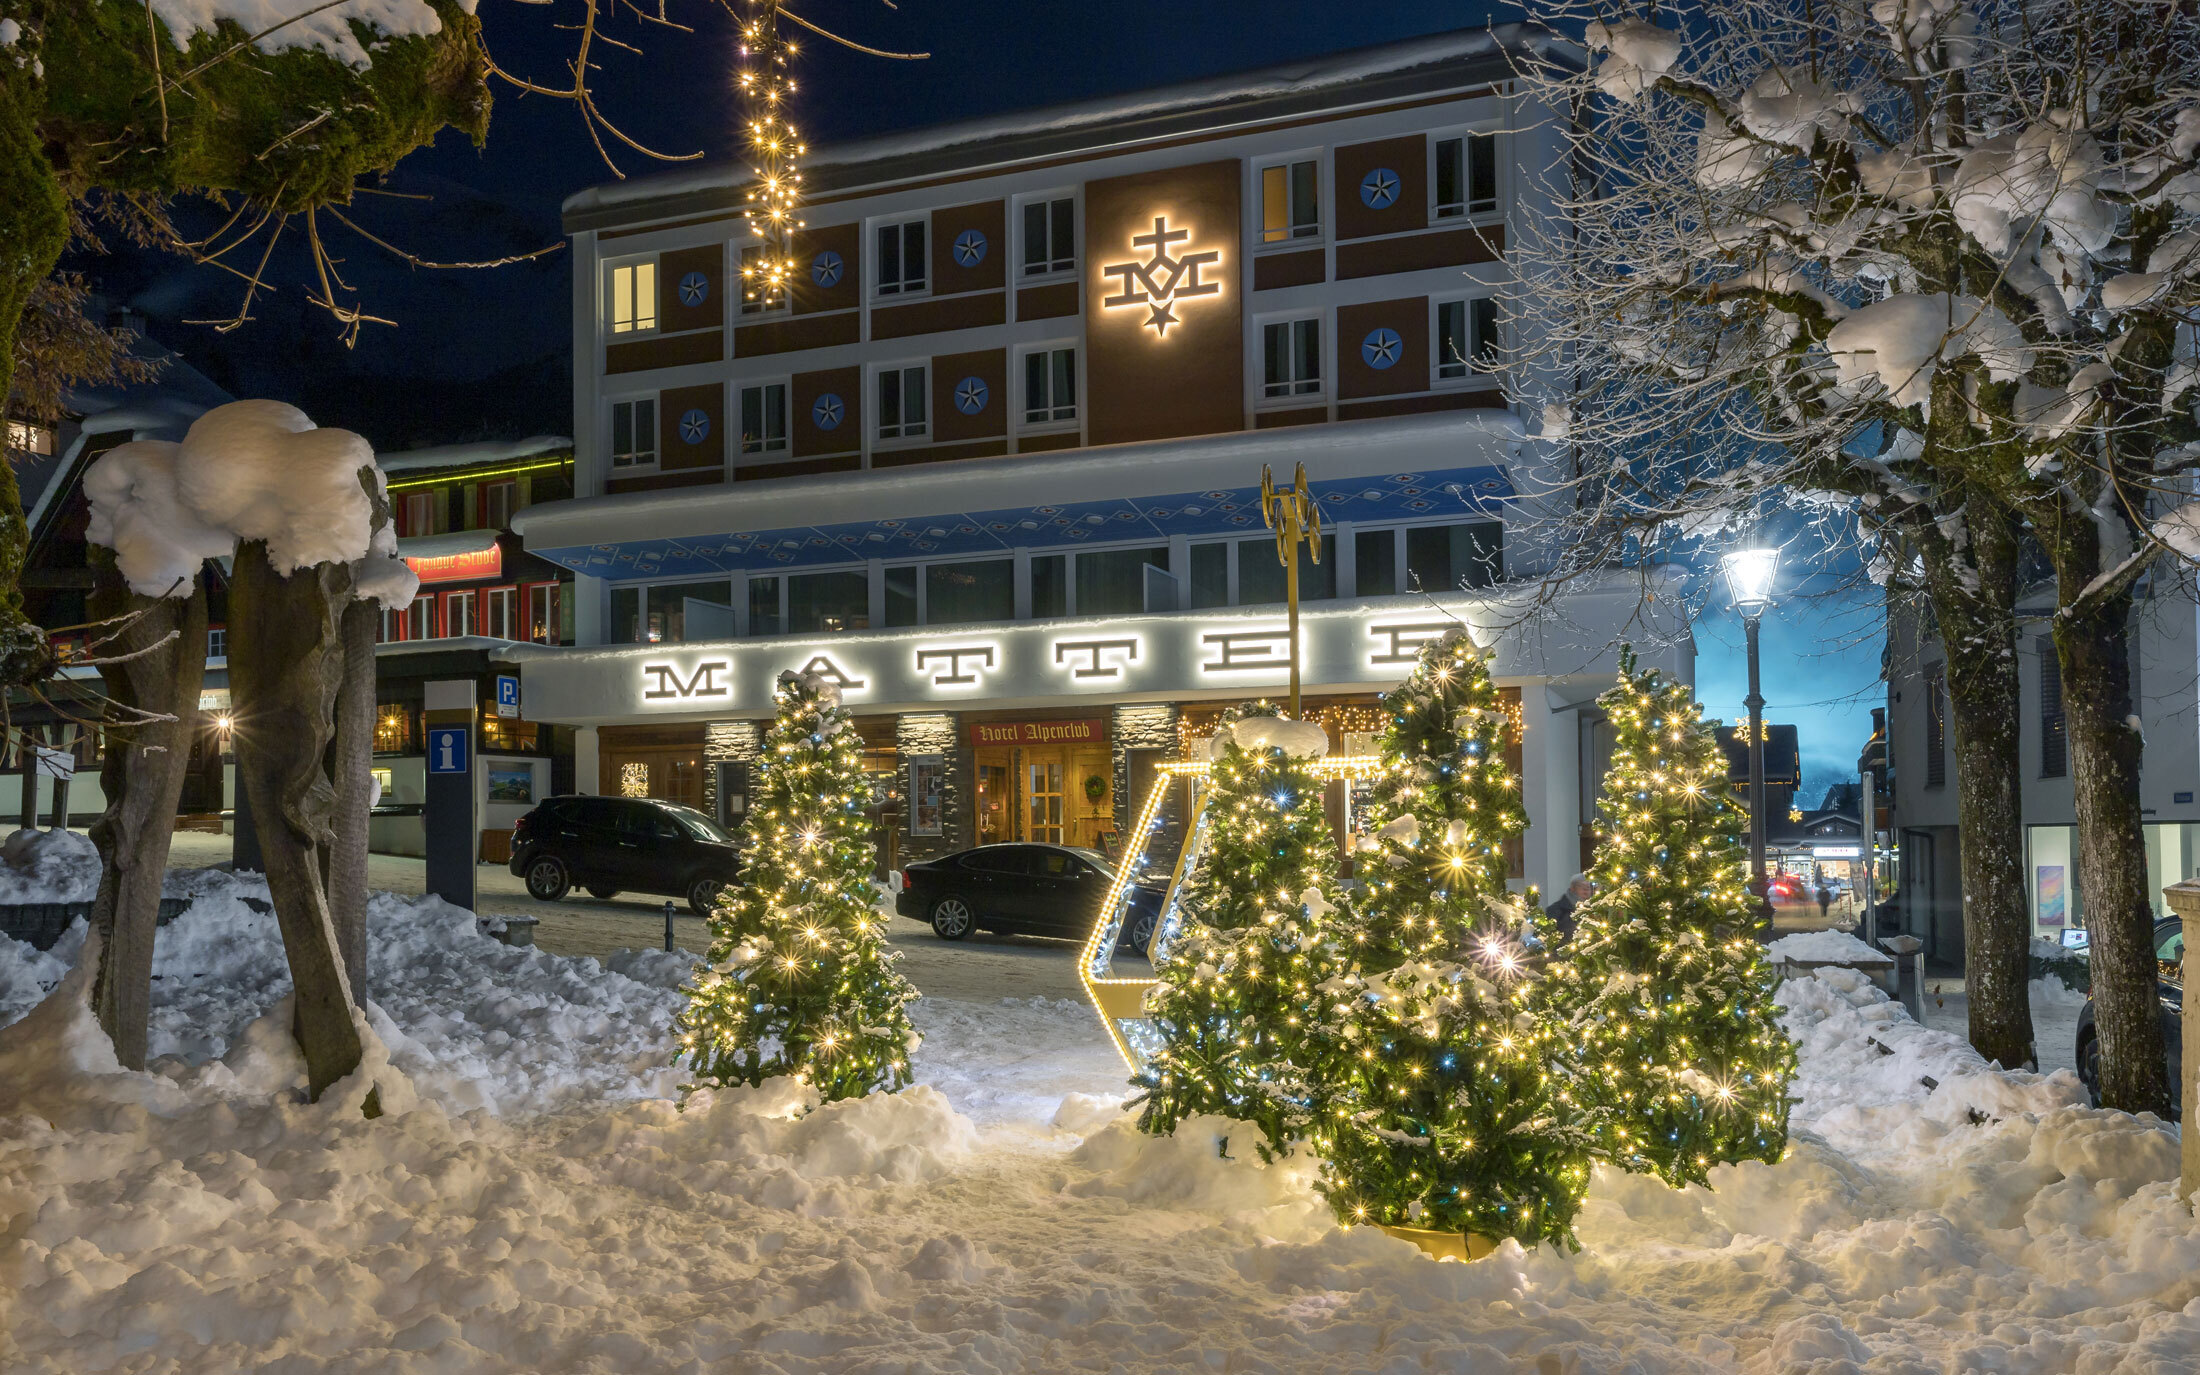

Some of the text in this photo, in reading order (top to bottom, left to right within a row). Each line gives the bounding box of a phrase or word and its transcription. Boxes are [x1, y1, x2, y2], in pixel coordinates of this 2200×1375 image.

[459, 550, 496, 568] Stube
[503, 682, 513, 702] P
[980, 722, 1090, 742] Hotel Alpenclub
